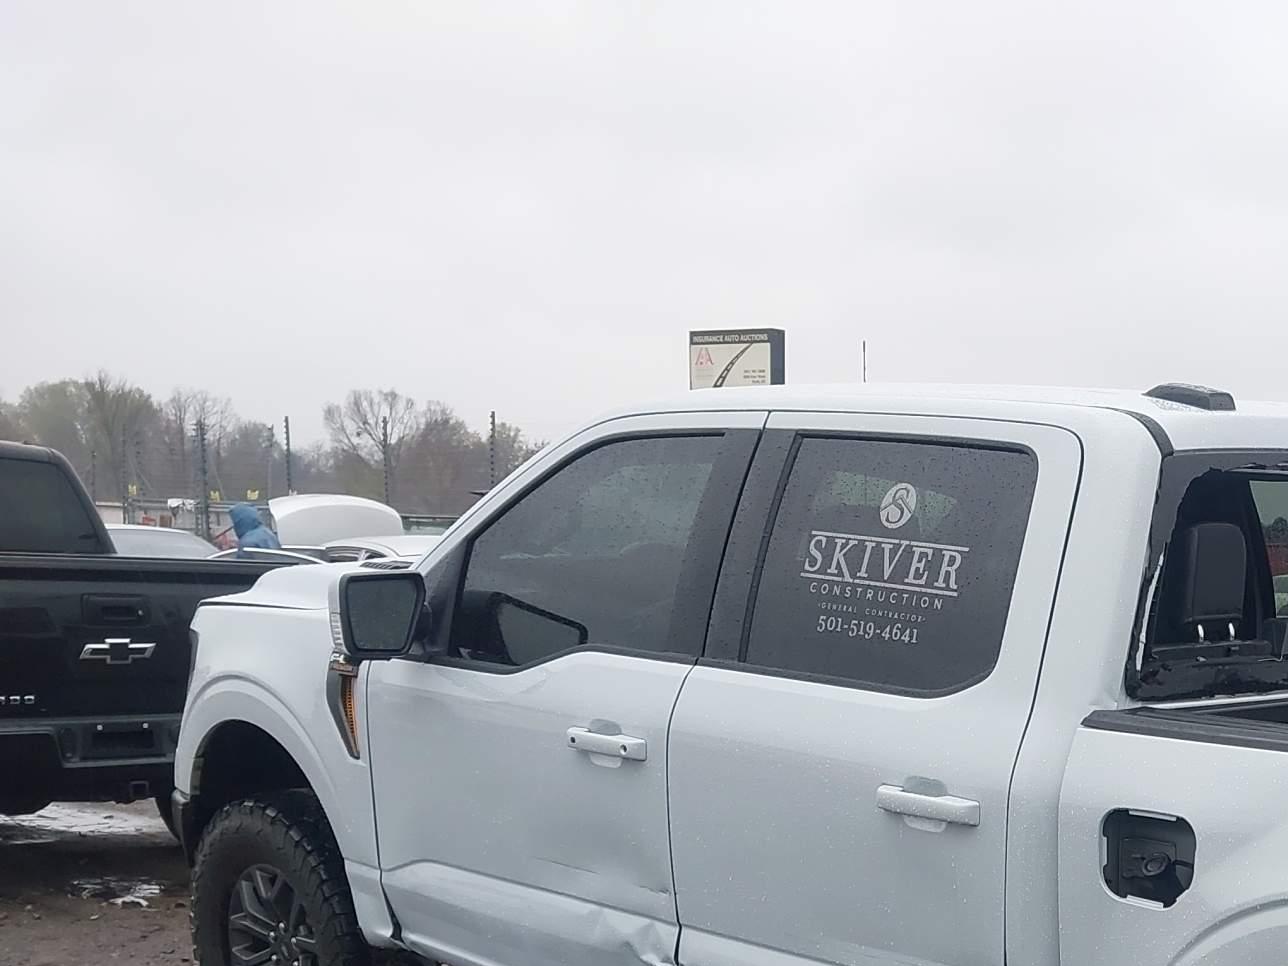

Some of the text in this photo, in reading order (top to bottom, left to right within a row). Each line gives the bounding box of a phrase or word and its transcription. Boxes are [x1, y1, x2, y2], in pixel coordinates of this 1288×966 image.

[803, 535, 963, 589] SKIVER
[809, 582, 944, 610] CONSTRUCTION
[816, 615, 919, 644] 501-519-4641
